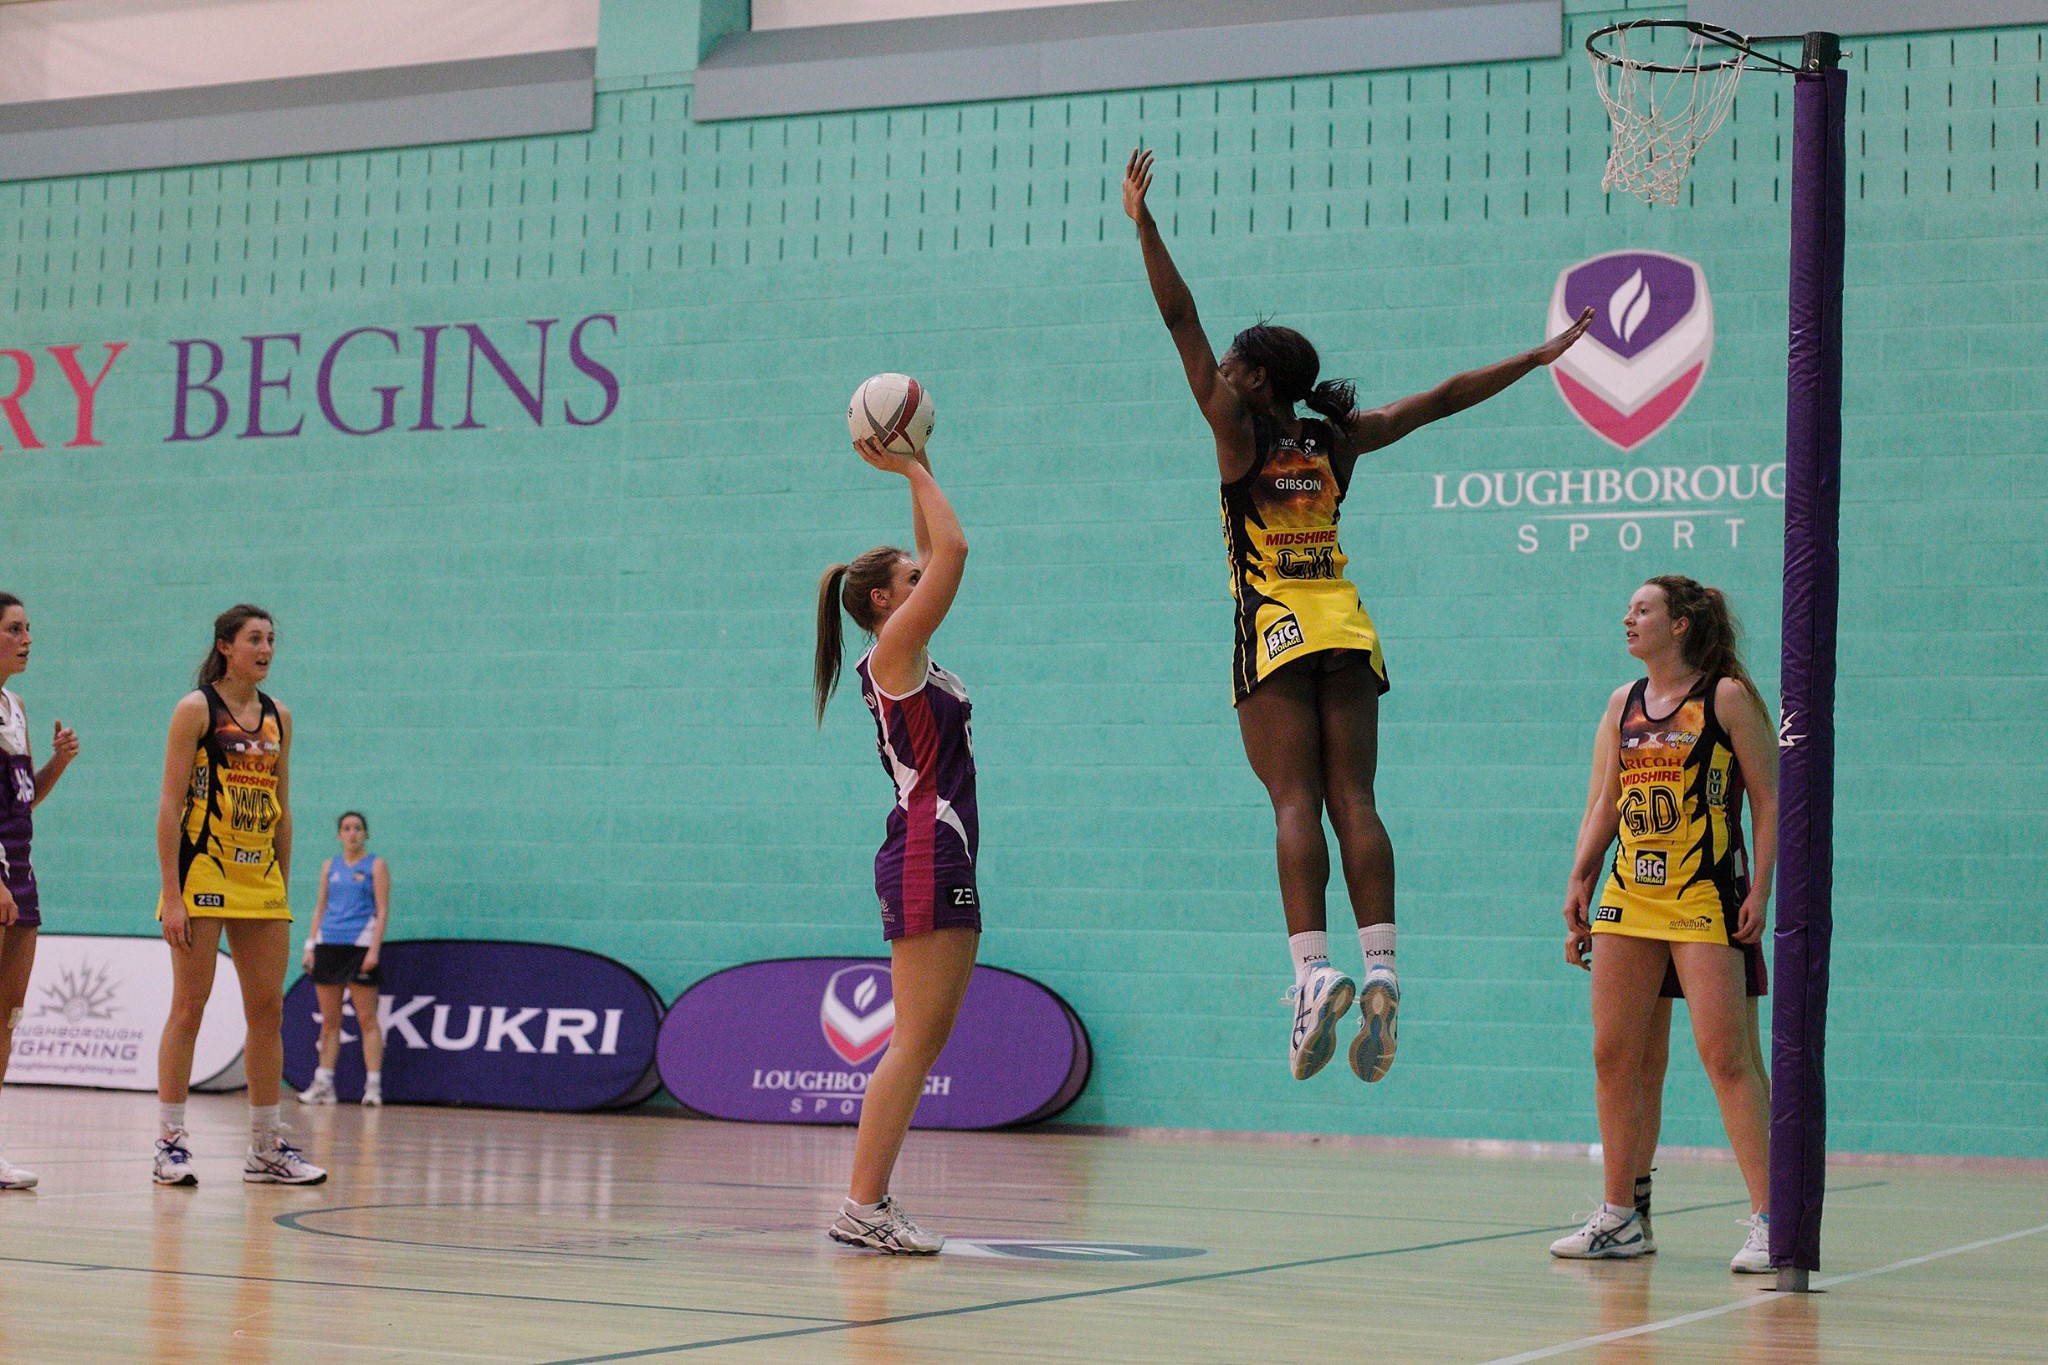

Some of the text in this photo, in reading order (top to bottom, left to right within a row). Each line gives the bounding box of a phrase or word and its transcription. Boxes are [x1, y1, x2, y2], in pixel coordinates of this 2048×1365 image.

[163, 314, 621, 442] BEGINS
[1275, 478, 1322, 491] GIBSON
[1432, 462, 1786, 510] LOUGHBOROUG
[1265, 530, 1337, 546] MIDSHIRE
[1516, 518, 1746, 554] SPORT
[1275, 546, 1338, 580] GK
[1270, 636, 1302, 658] STORAGE
[1626, 756, 1681, 770] RICOH
[1621, 770, 1681, 788] MIDSHIRE
[228, 785, 277, 833] WD
[1621, 785, 1681, 837] GD
[953, 888, 975, 905] ZE
[14, 1024, 144, 1040] UGHBOROUGH
[378, 994, 623, 1055] KUKRI
[11, 1040, 138, 1061] IGHTNING
[789, 1098, 855, 1116] SPO
